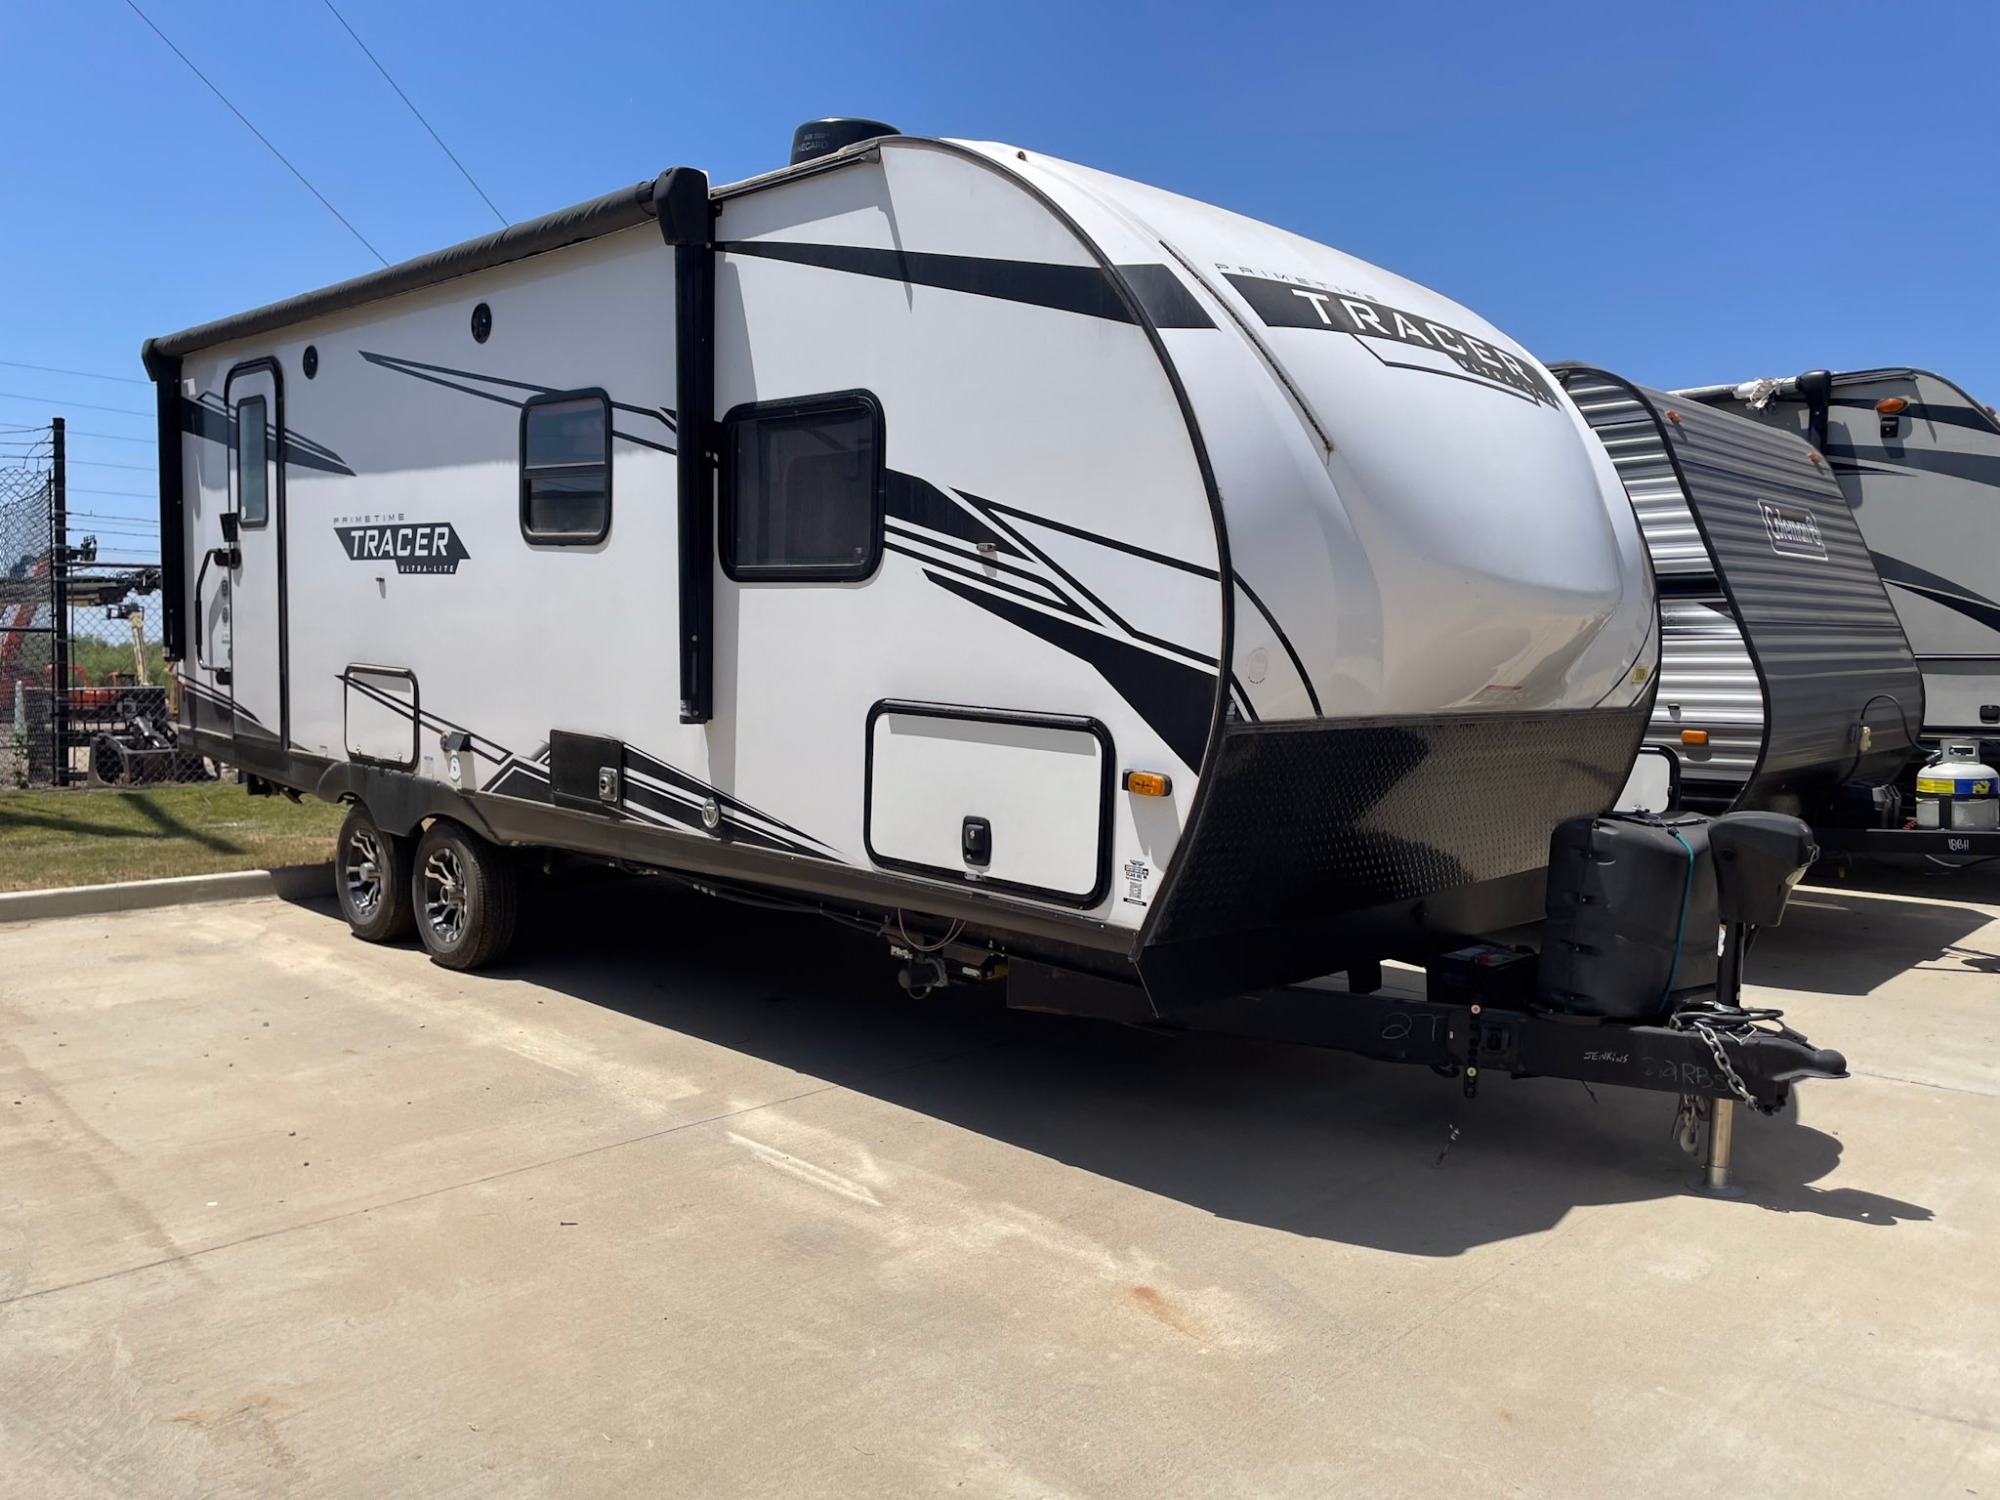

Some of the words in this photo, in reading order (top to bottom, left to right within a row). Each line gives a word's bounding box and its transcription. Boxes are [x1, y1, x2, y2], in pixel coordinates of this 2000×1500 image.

[1214, 262, 1379, 303] PRIMETIME
[1291, 288, 1533, 384] TRACER
[333, 513, 405, 525] PRIMETIME
[350, 526, 450, 557] TRACER
[399, 565, 455, 573] ULTRA-LITE
